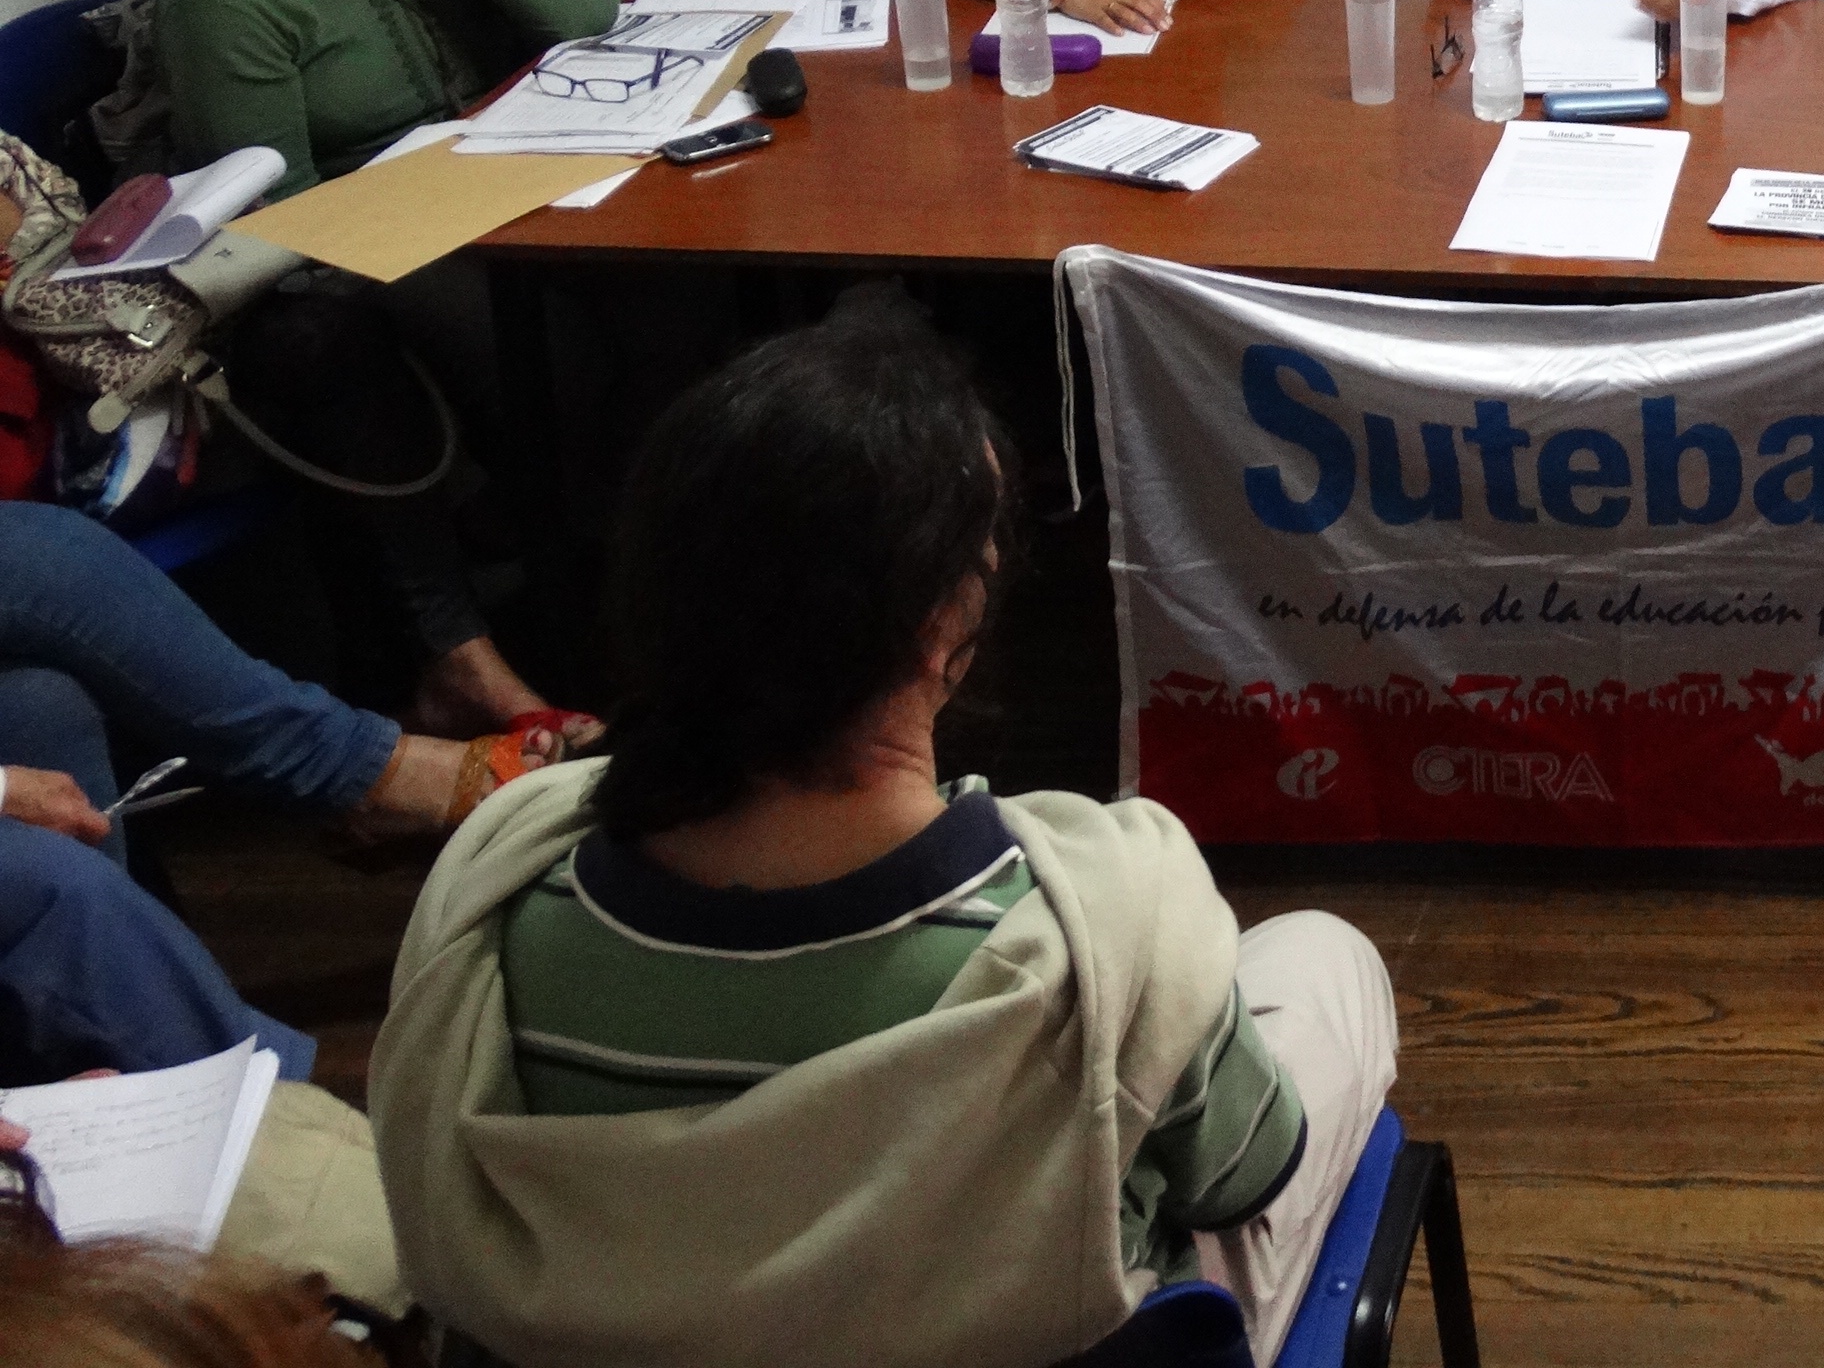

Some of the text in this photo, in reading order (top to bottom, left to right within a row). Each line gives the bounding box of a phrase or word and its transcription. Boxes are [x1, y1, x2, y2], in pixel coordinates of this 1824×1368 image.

[1258, 591, 1303, 621] en
[1318, 585, 1464, 640] defensa
[1480, 583, 1524, 627] de
[1538, 582, 1581, 625] la
[1599, 583, 1803, 627] educación
[1412, 744, 1615, 802] CTERA
